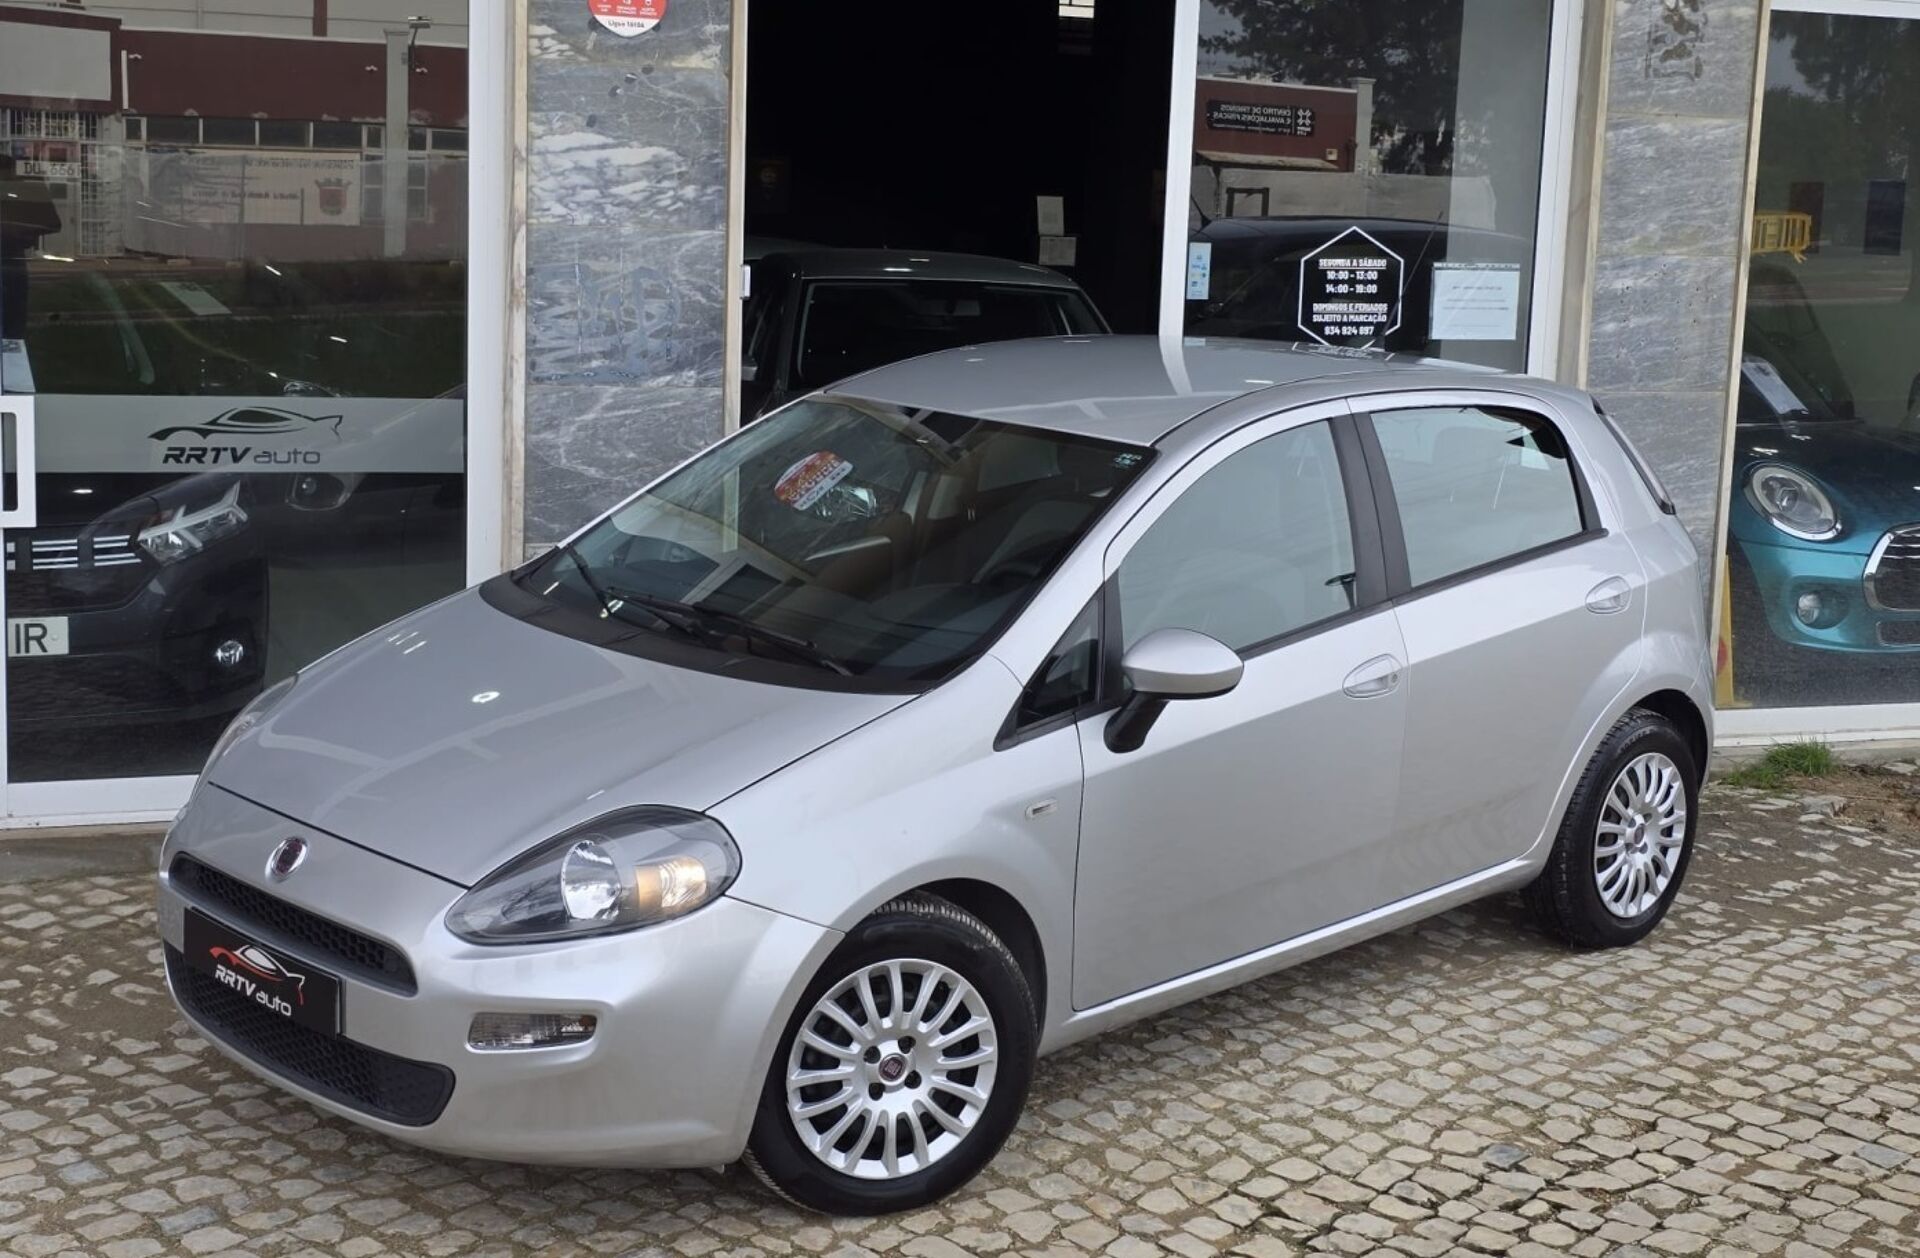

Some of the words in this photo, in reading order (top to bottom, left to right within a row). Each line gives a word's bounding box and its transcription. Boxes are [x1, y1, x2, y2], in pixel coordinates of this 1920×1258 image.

[1319, 258, 1350, 267] SEGUNDA
[1352, 259, 1358, 267] A
[1326, 271, 1349, 280] 10:00
[1325, 284, 1348, 293] 14:00
[1313, 303, 1346, 312] DOMINGOS
[1355, 303, 1388, 312] FERIADOS
[1313, 314, 1341, 322] SUJEITO
[1342, 314, 1348, 322] A
[162, 446, 252, 464] RRTV
[253, 448, 321, 464] auto
[15, 623, 48, 654] IR
[214, 964, 257, 997] RRTV
[256, 990, 292, 1017] auto
